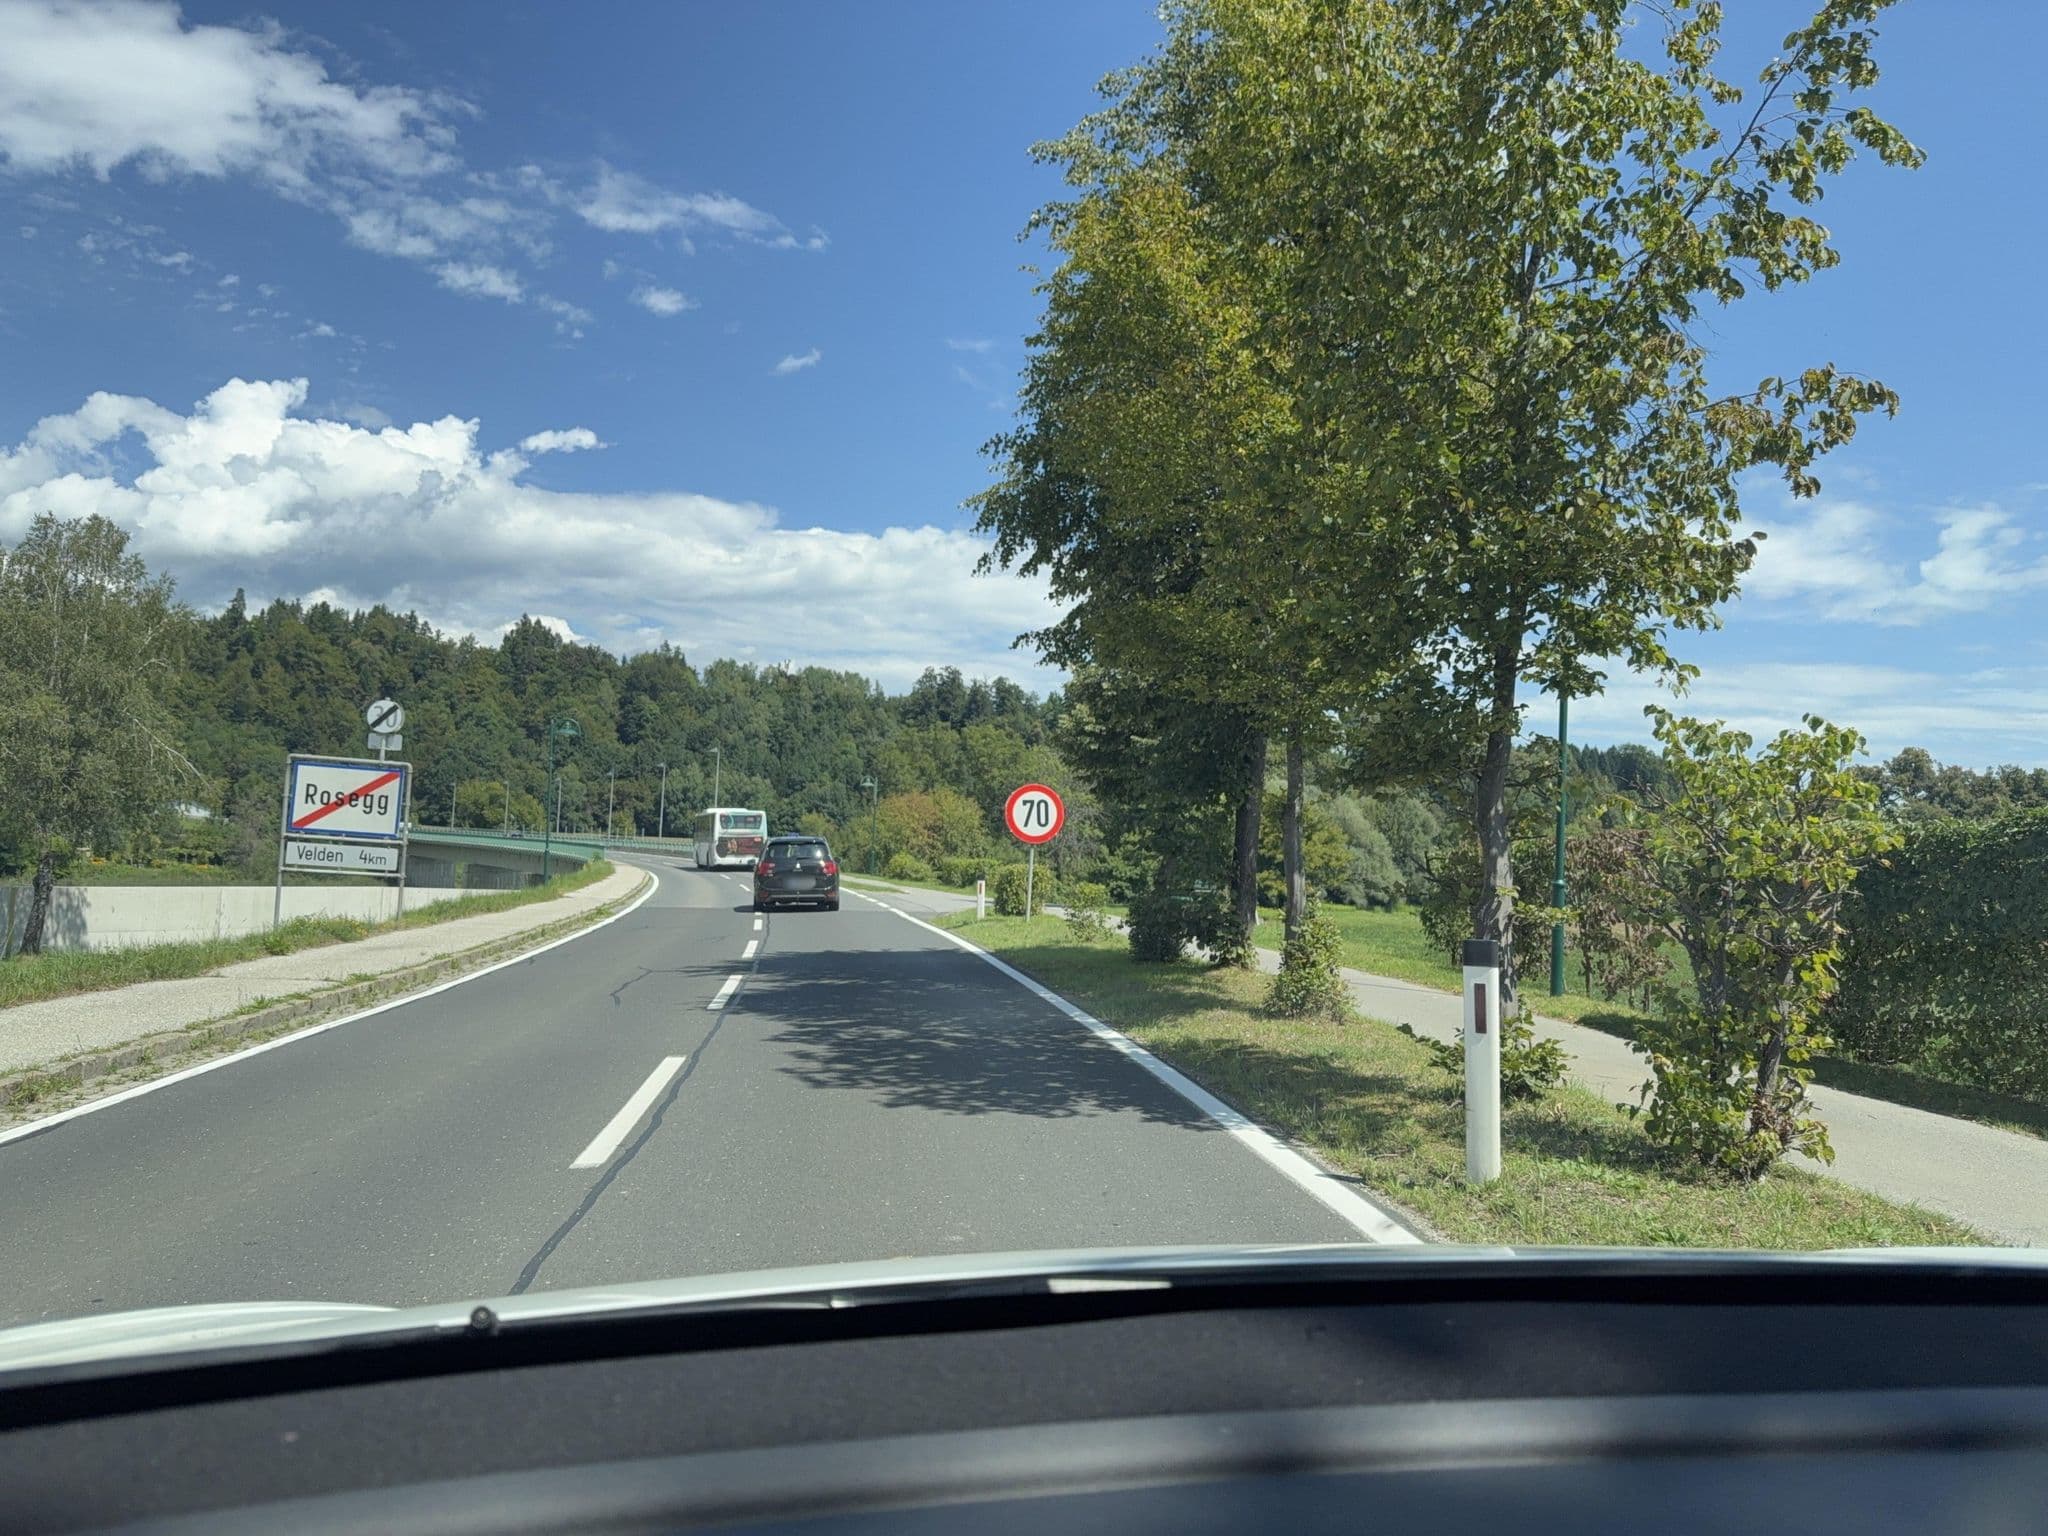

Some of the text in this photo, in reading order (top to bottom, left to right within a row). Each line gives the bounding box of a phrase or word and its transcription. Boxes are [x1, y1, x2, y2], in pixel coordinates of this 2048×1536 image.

[304, 783, 389, 816] Rosegg
[1022, 798, 1049, 828] 70
[297, 845, 387, 866] Velden 4km
